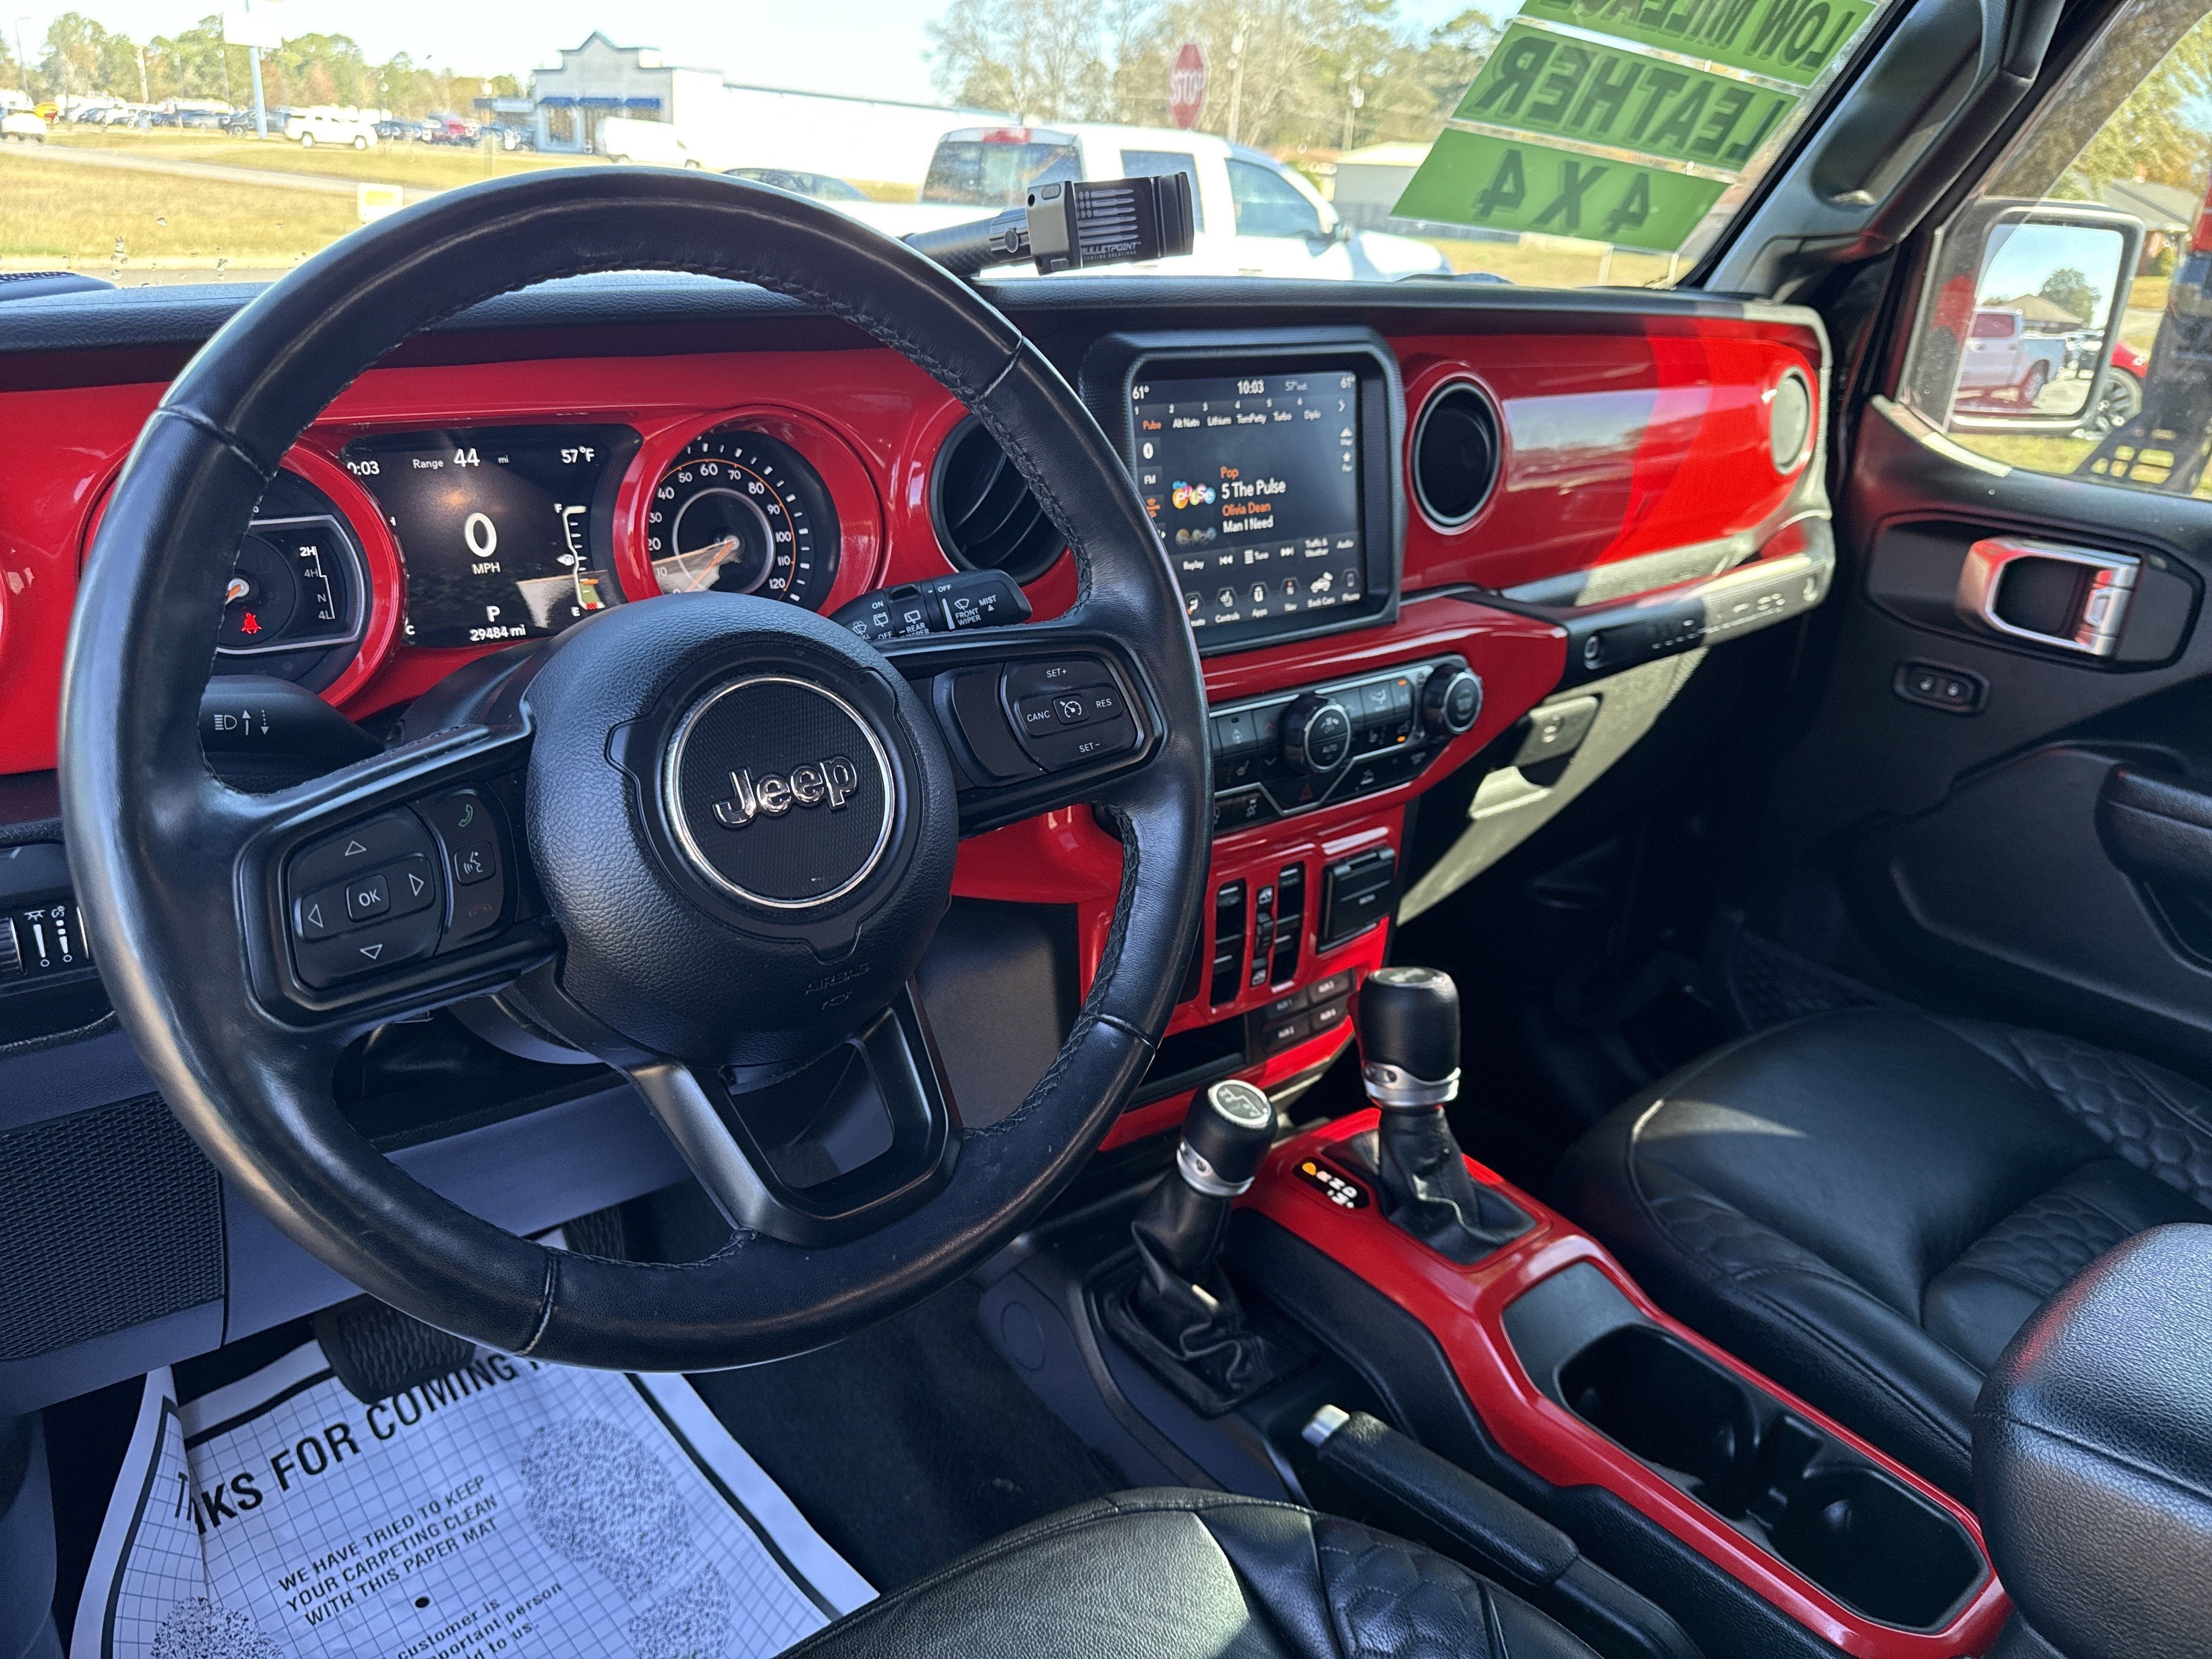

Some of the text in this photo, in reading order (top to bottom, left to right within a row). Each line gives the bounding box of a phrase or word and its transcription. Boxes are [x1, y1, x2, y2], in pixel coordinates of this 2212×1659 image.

[1237, 379, 1265, 394] 10:03
[1203, 402, 1208, 411] 3
[1235, 400, 1240, 409] 4
[1266, 398, 1272, 407] 5
[1297, 397, 1303, 405] 6
[1135, 405, 1139, 415] 1
[1169, 404, 1175, 414] 2
[1143, 420, 1161, 430] Pulse
[413, 448, 509, 469] Range 44 mi
[561, 447, 595, 463] 57°F
[347, 461, 380, 475] 0:03
[700, 463, 718, 476] 60
[1220, 466, 1239, 480] Pop
[678, 472, 692, 483] 50
[728, 470, 741, 480] 70
[658, 487, 675, 499] 40
[748, 482, 765, 494] 80
[1221, 477, 1286, 499] 5 The Pulse
[555, 504, 562, 514] F
[768, 504, 780, 515] 90
[1222, 501, 1271, 516] Olivia Dean
[649, 512, 662, 523] 30
[1223, 515, 1273, 533] Man I Need
[465, 512, 496, 557] 0
[776, 531, 791, 543] 100
[648, 537, 661, 551] 20
[300, 546, 316, 557] 2H
[777, 555, 791, 566] 110
[1183, 560, 1205, 571] Replay
[304, 569, 318, 578] 4H
[472, 562, 500, 575] MPH
[656, 566, 668, 578] 10
[769, 578, 786, 589] 120
[938, 584, 951, 592] OFF
[317, 594, 327, 602] N
[979, 595, 997, 606] MIST
[872, 601, 884, 610] ON
[318, 611, 334, 619] 4L
[487, 605, 500, 622] P
[572, 608, 580, 617] E
[955, 608, 979, 619] FRONT
[1215, 611, 1240, 623] Controls
[957, 616, 980, 627] WIPER
[469, 624, 526, 641] 29484 mi
[906, 623, 926, 633] REAR
[1096, 698, 1112, 709] RES
[1027, 710, 1050, 722] CANC
[714, 755, 858, 826] Jeep
[359, 889, 381, 906] OK
[269, 1423, 359, 1492] FOR
[366, 1353, 520, 1441] COMING
[278, 1474, 486, 1593] WE HAVE TRIED TO KEEP
[286, 1495, 498, 1613] YOUR CARPETING CLEAN
[304, 1517, 498, 1627] WITH THIS PAPER MAT
[431, 1582, 562, 1659] portant person
[398, 1598, 500, 1659] customer is
[488, 1638, 507, 1654] to
[511, 1622, 540, 1640] us.
